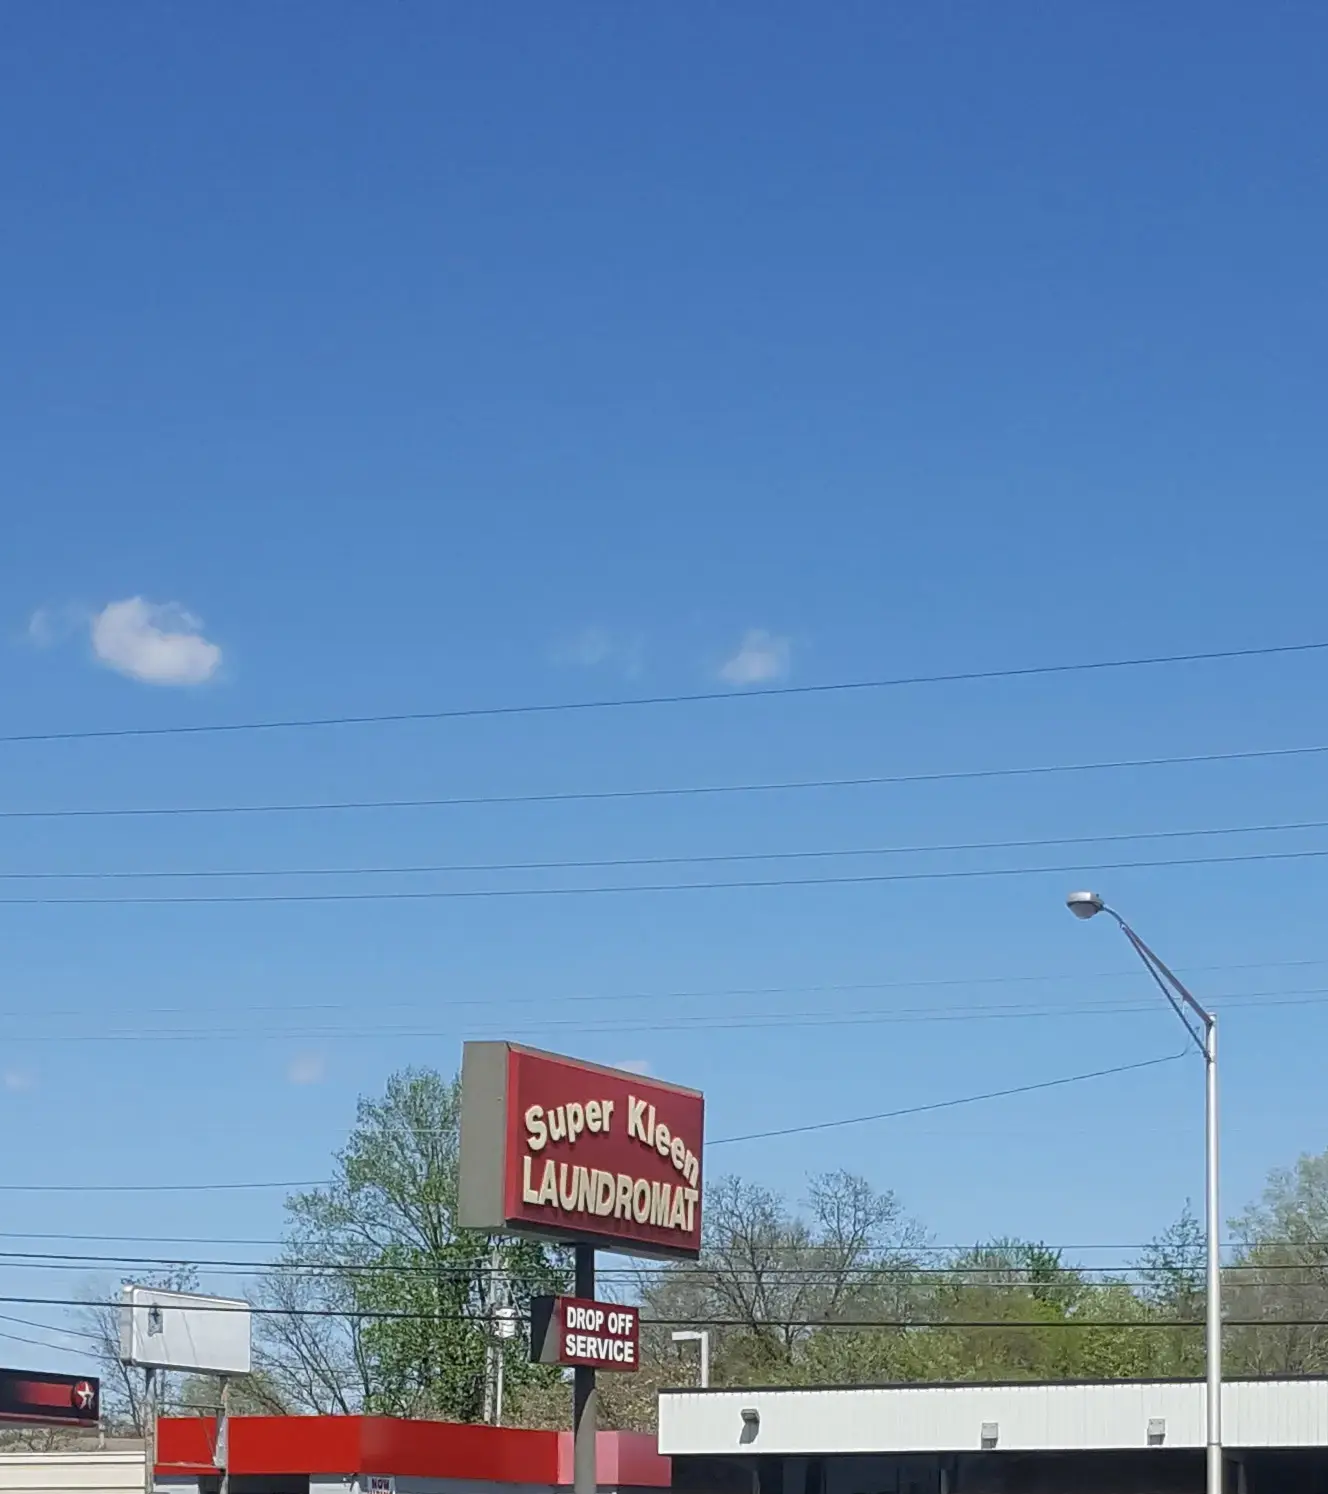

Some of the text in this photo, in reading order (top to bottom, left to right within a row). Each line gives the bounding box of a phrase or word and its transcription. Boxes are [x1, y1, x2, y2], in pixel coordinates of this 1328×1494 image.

[525, 1095, 699, 1188] Super Kleen
[523, 1156, 698, 1232] LAUNDROMAT
[566, 1306, 633, 1336] DROP OFF
[565, 1334, 635, 1363] SERVICE
[371, 1477, 389, 1490] NOW
